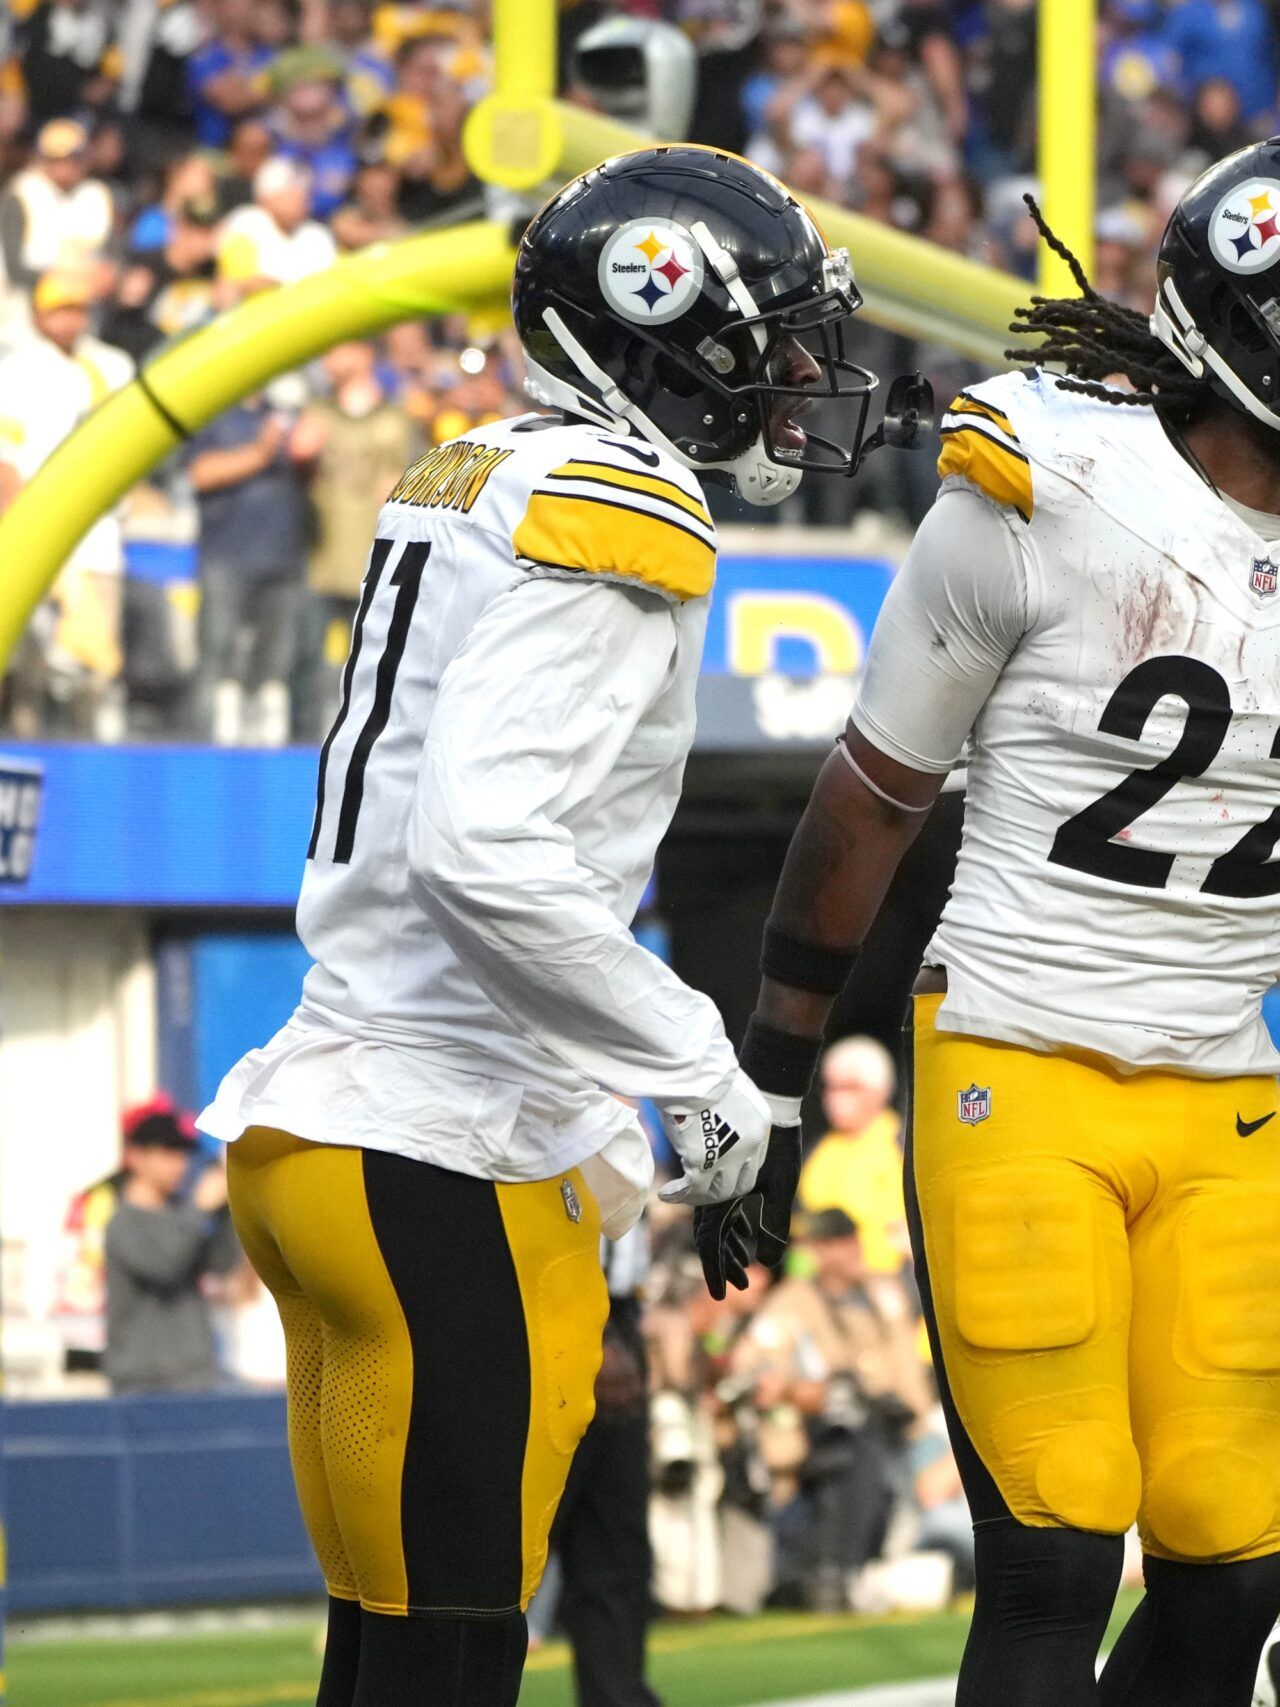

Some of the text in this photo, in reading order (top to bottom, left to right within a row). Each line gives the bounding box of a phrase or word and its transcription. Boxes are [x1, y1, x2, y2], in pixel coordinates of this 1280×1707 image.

[1222, 208, 1249, 225] Steelers
[612, 263, 646, 273] Steelers
[1254, 573, 1275, 592] NFL
[307, 538, 432, 864] 11
[963, 1102, 985, 1117] NFL
[701, 1109, 719, 1170] adidas
